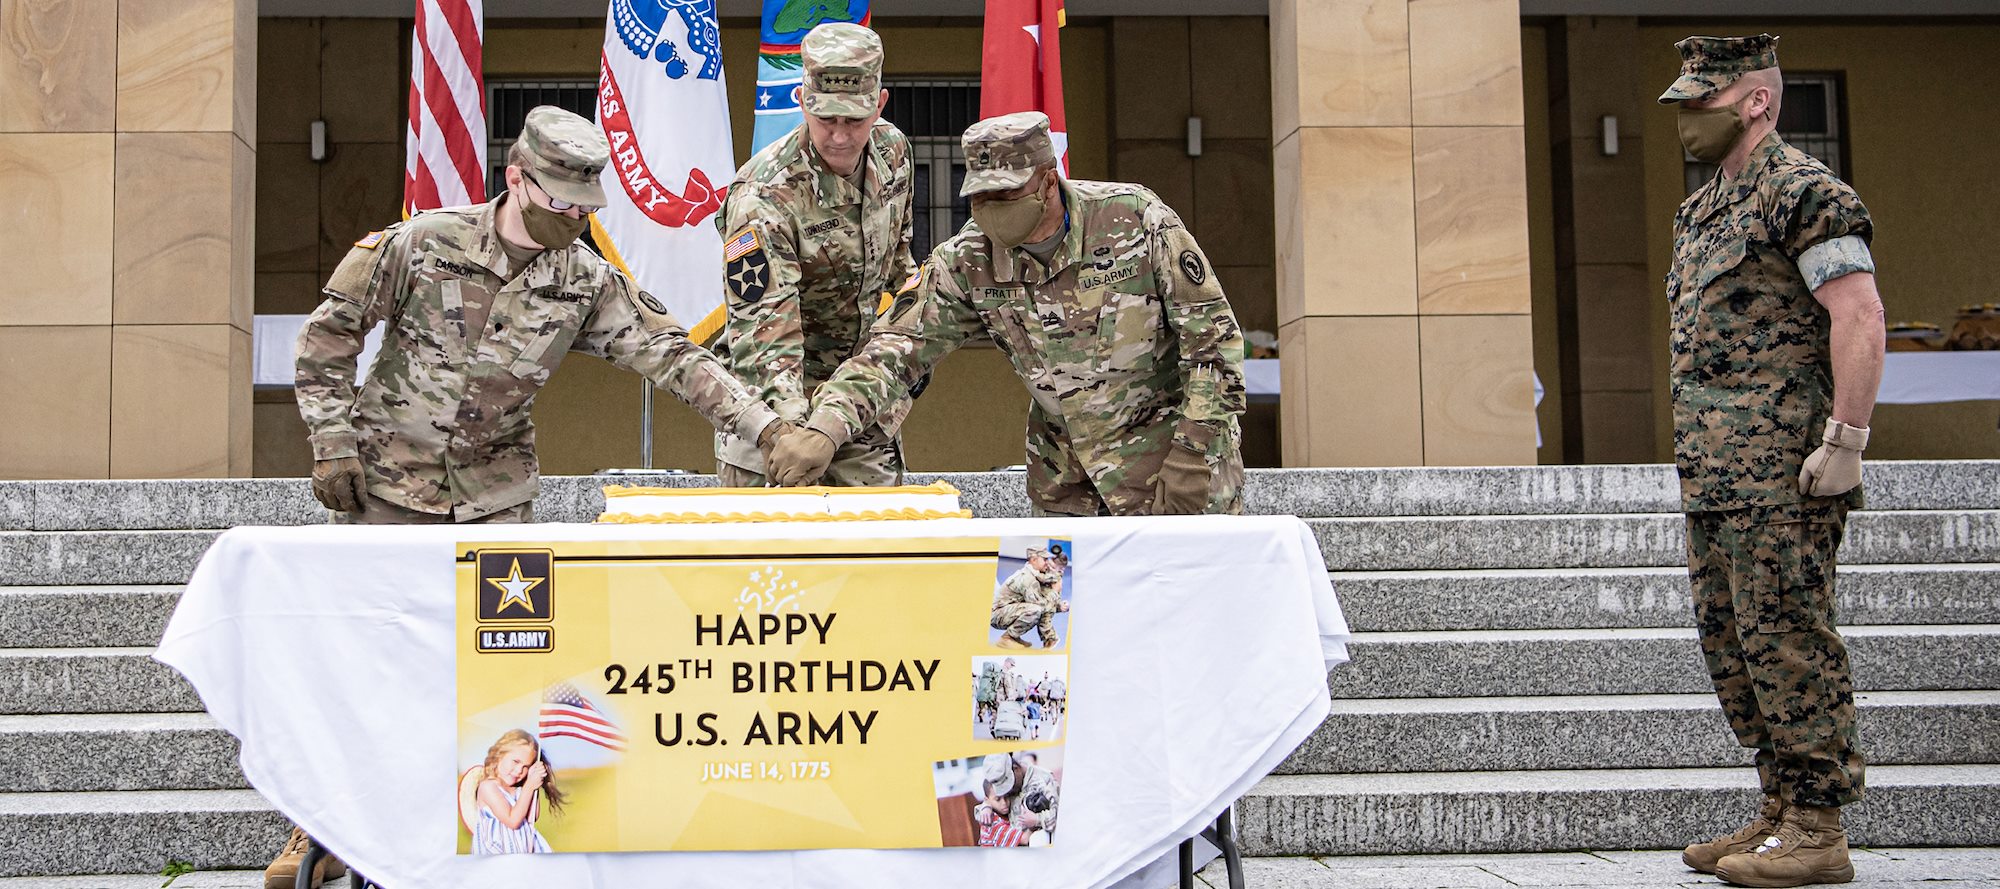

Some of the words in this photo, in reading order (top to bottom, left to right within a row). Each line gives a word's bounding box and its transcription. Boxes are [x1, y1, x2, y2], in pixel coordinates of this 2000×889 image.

[600, 57, 620, 118] TES
[611, 130, 669, 211] ARMY
[985, 288, 1021, 299] PRATT
[695, 612, 837, 646] HAPPY
[732, 658, 942, 694] BIRTHDAY
[654, 712, 728, 747] U.S.
[742, 709, 880, 746] ARMY
[700, 761, 753, 782] JUNE
[759, 761, 784, 781] 14,
[790, 761, 831, 779] 1775
